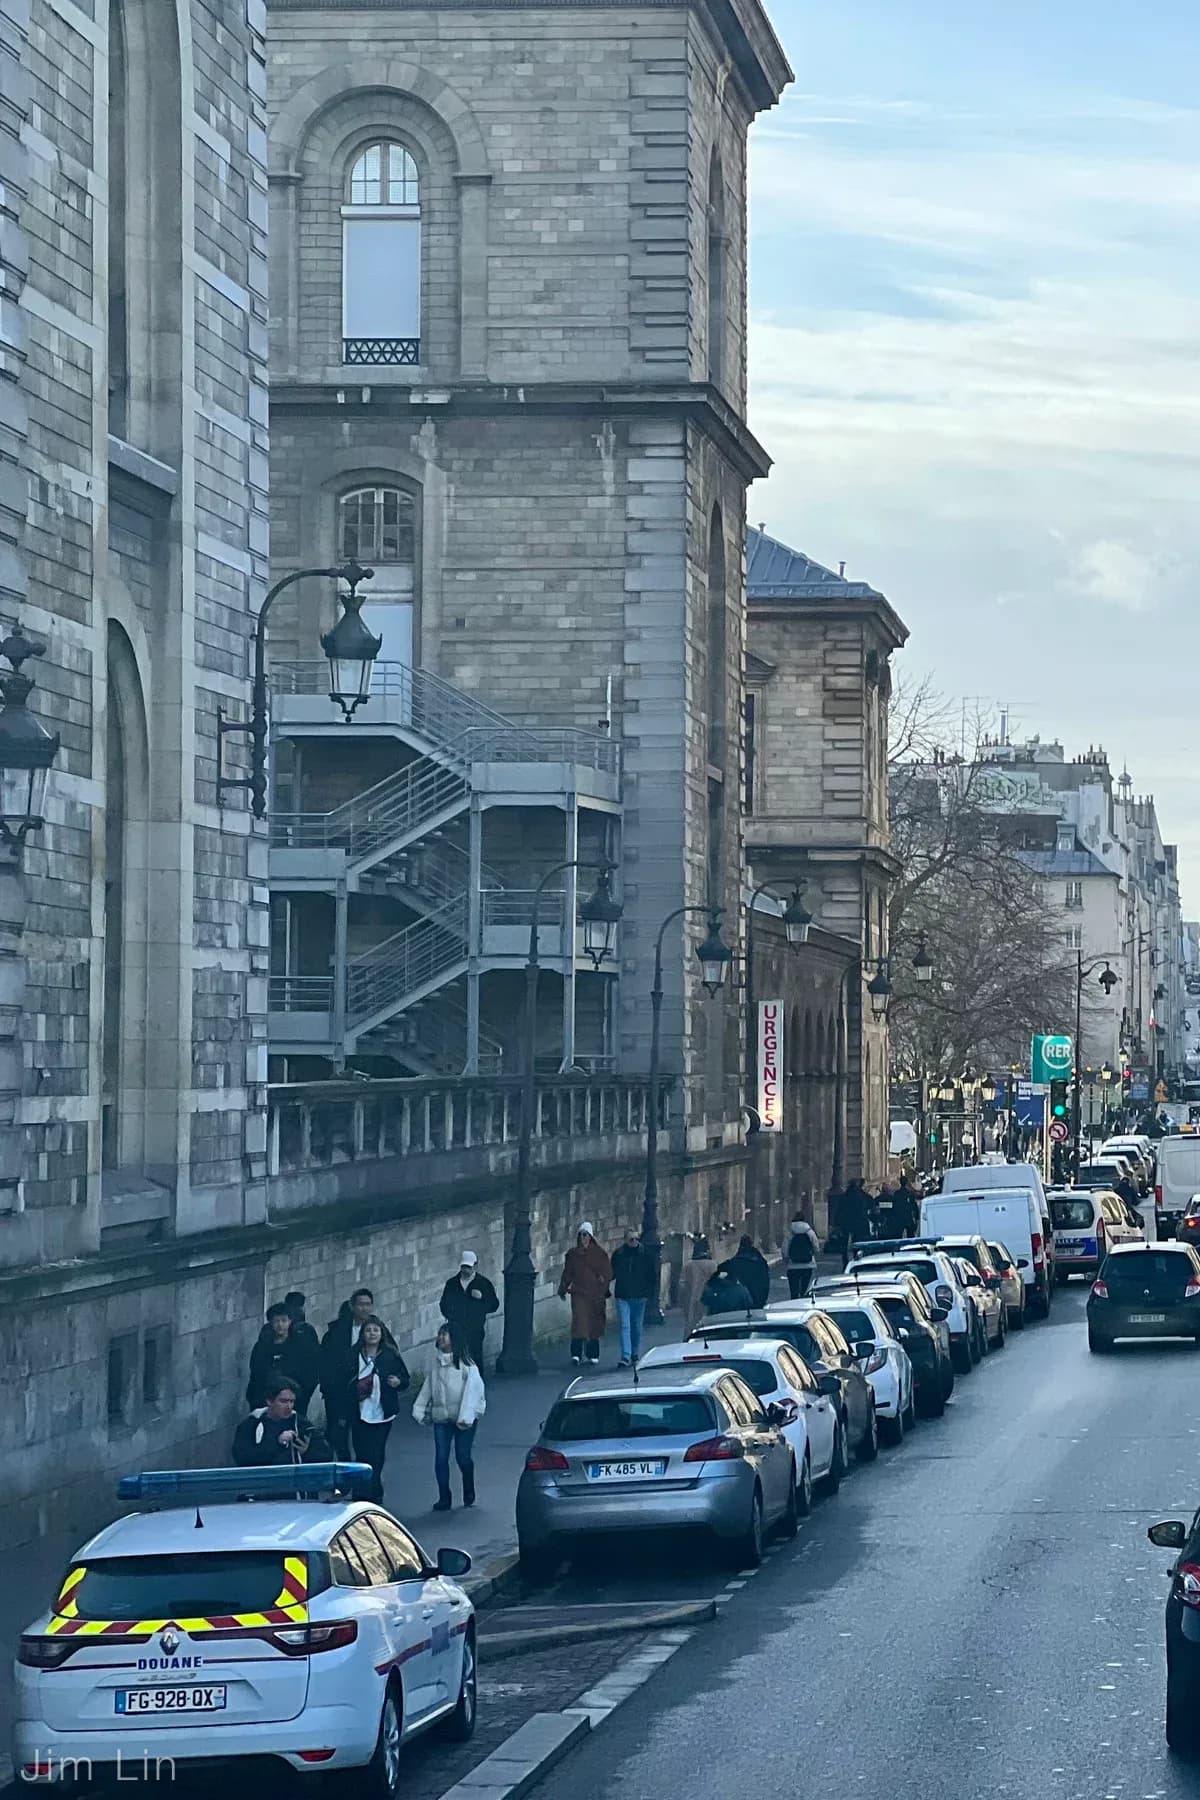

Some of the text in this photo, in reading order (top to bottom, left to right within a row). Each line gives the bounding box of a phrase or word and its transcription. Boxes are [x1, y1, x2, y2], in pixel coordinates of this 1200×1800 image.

[1046, 1044, 1071, 1058] RER
[763, 1004, 777, 1127] URGENCES
[138, 1656, 202, 1670] DOUANE
[128, 1689, 213, 1710] FG-928-QX
